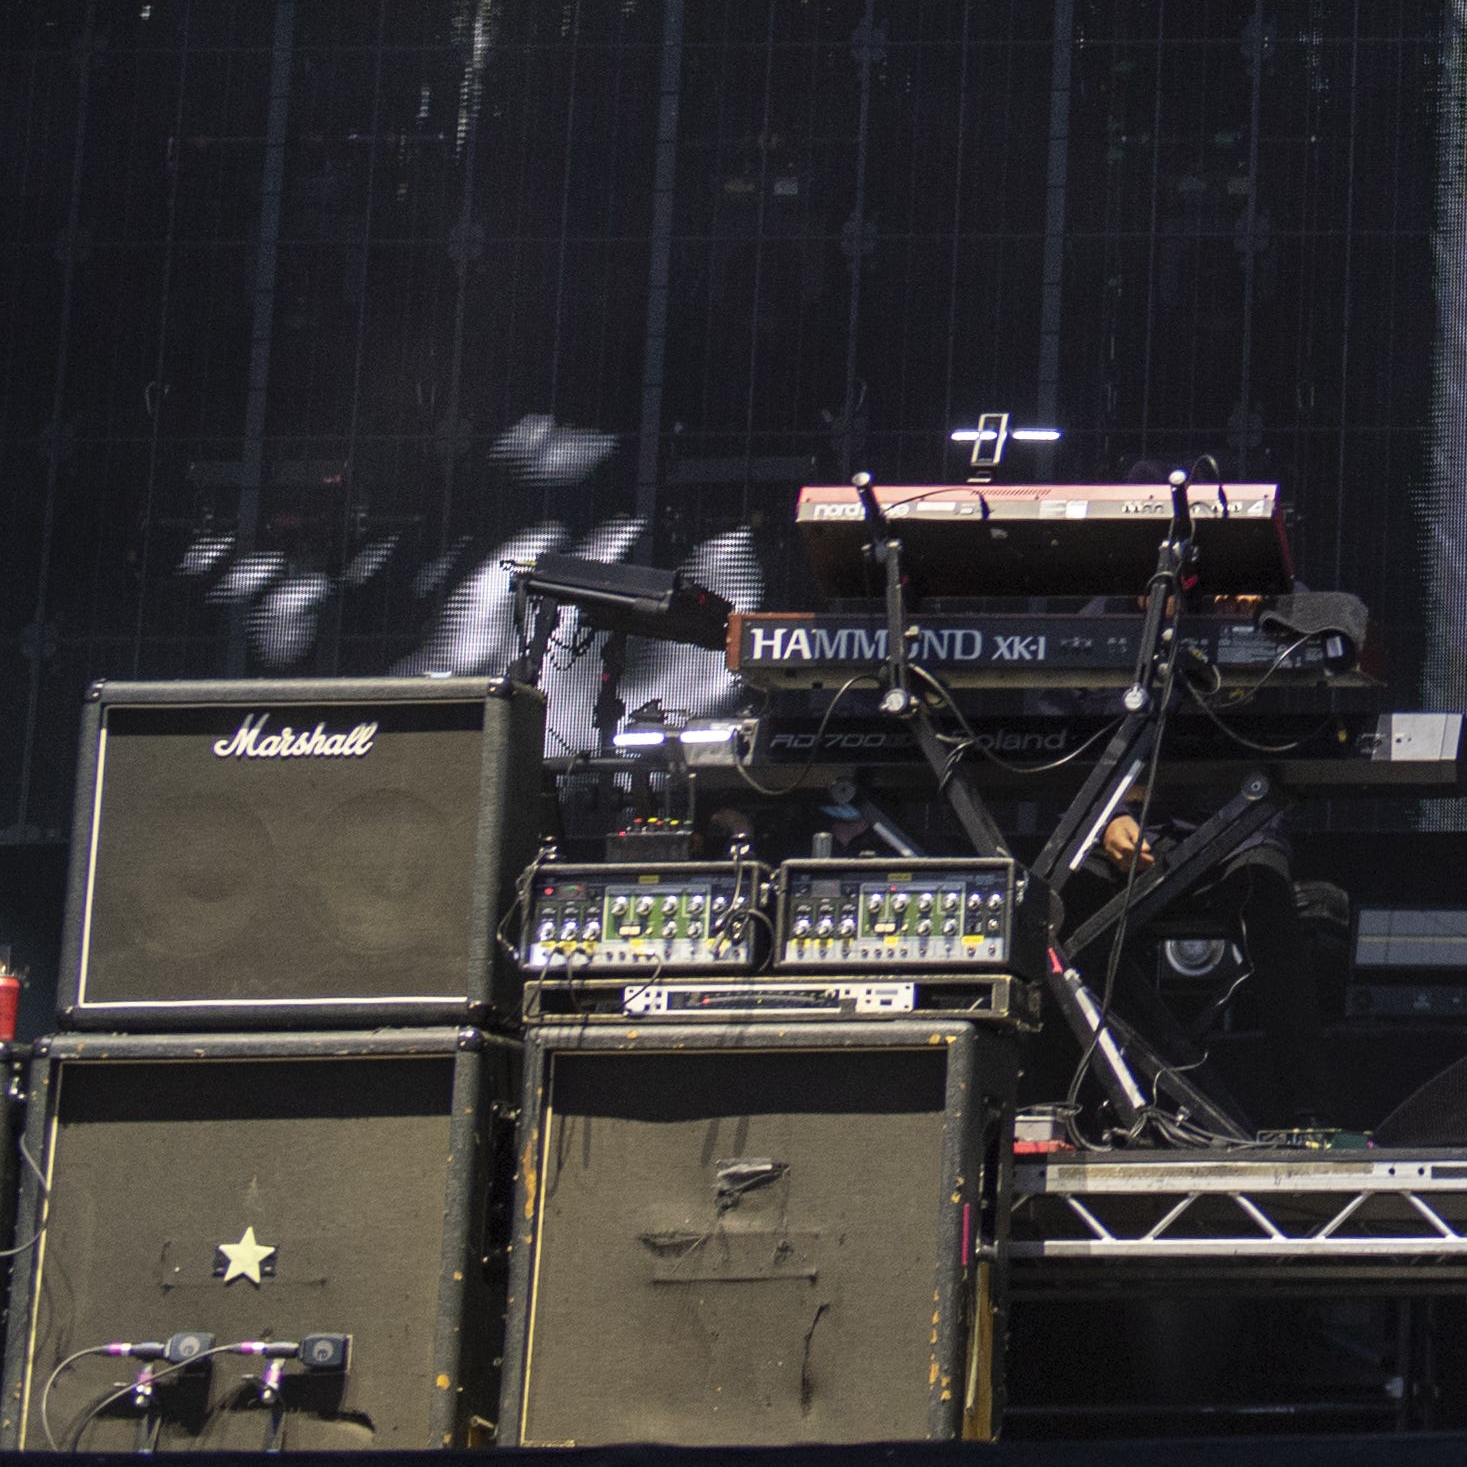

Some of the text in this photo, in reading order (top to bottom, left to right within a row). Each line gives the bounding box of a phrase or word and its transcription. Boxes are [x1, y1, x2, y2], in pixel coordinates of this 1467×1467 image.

[813, 501, 861, 521] nord
[750, 628, 983, 661] HAMMND
[213, 712, 379, 758] Marshall
[950, 728, 1067, 750] oland
